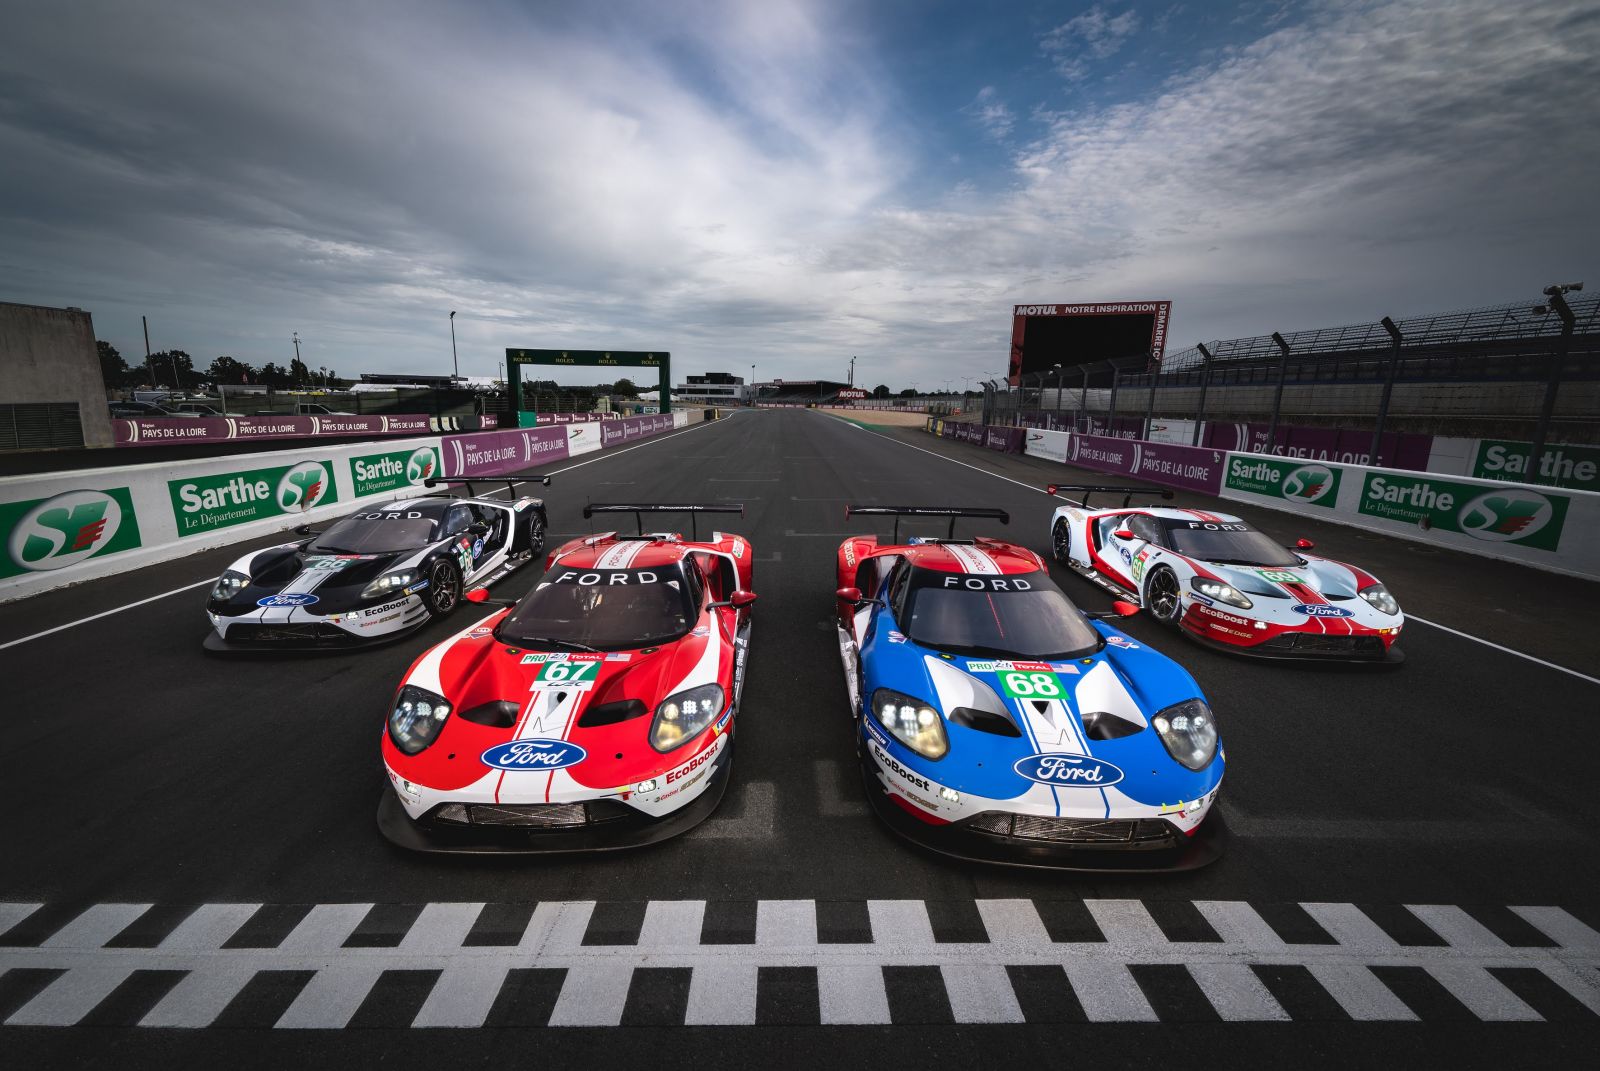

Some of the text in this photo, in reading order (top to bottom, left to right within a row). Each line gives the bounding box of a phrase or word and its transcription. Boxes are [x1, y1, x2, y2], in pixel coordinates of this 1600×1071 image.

[1016, 304, 1156, 315] MOTUL NOTRE INSPIRATION
[1153, 304, 1168, 361] DEMARRE IC
[840, 390, 865, 398] MOTUL
[142, 427, 206, 438] PAYS DE LA LOIRE
[240, 426, 257, 434] PAYS
[268, 425, 276, 433] LA
[277, 425, 295, 433] LOIRE
[532, 441, 542, 453] PAYS
[543, 441, 548, 452] DE
[549, 440, 554, 450] LA
[554, 439, 564, 450] LOIRE
[467, 447, 516, 466] PAYS DE LA LOIRE
[1080, 448, 1122, 464] PAYS DE LA LOIRE
[355, 456, 403, 481] Sarthe
[1143, 458, 1209, 480] PAYS DE LA LOIRE
[1231, 459, 1280, 483] Sarthe
[358, 478, 396, 492] Le Département
[179, 476, 270, 513] Sarthe
[1368, 478, 1454, 511] Sarthe
[1365, 500, 1375, 510] Le
[185, 506, 257, 529] Le Département
[352, 511, 422, 520] FORD
[1188, 522, 1247, 531] FORD
[315, 559, 347, 570] 66
[555, 572, 658, 586] FORD
[1263, 571, 1299, 581] 69
[944, 577, 1031, 591] FORD
[267, 594, 308, 605] Ford
[364, 598, 410, 617] EcoBoost
[1306, 605, 1344, 616] Ford
[1200, 606, 1248, 626] EcoBoost
[1228, 629, 1254, 638] EDGE
[523, 655, 547, 663] PRO
[544, 661, 596, 681] 67
[1006, 673, 1060, 695] 68
[500, 743, 568, 765] Ford
[666, 743, 718, 784] EcoBoost
[875, 744, 930, 791] EcoBoost
[1037, 757, 1104, 782] Ford
